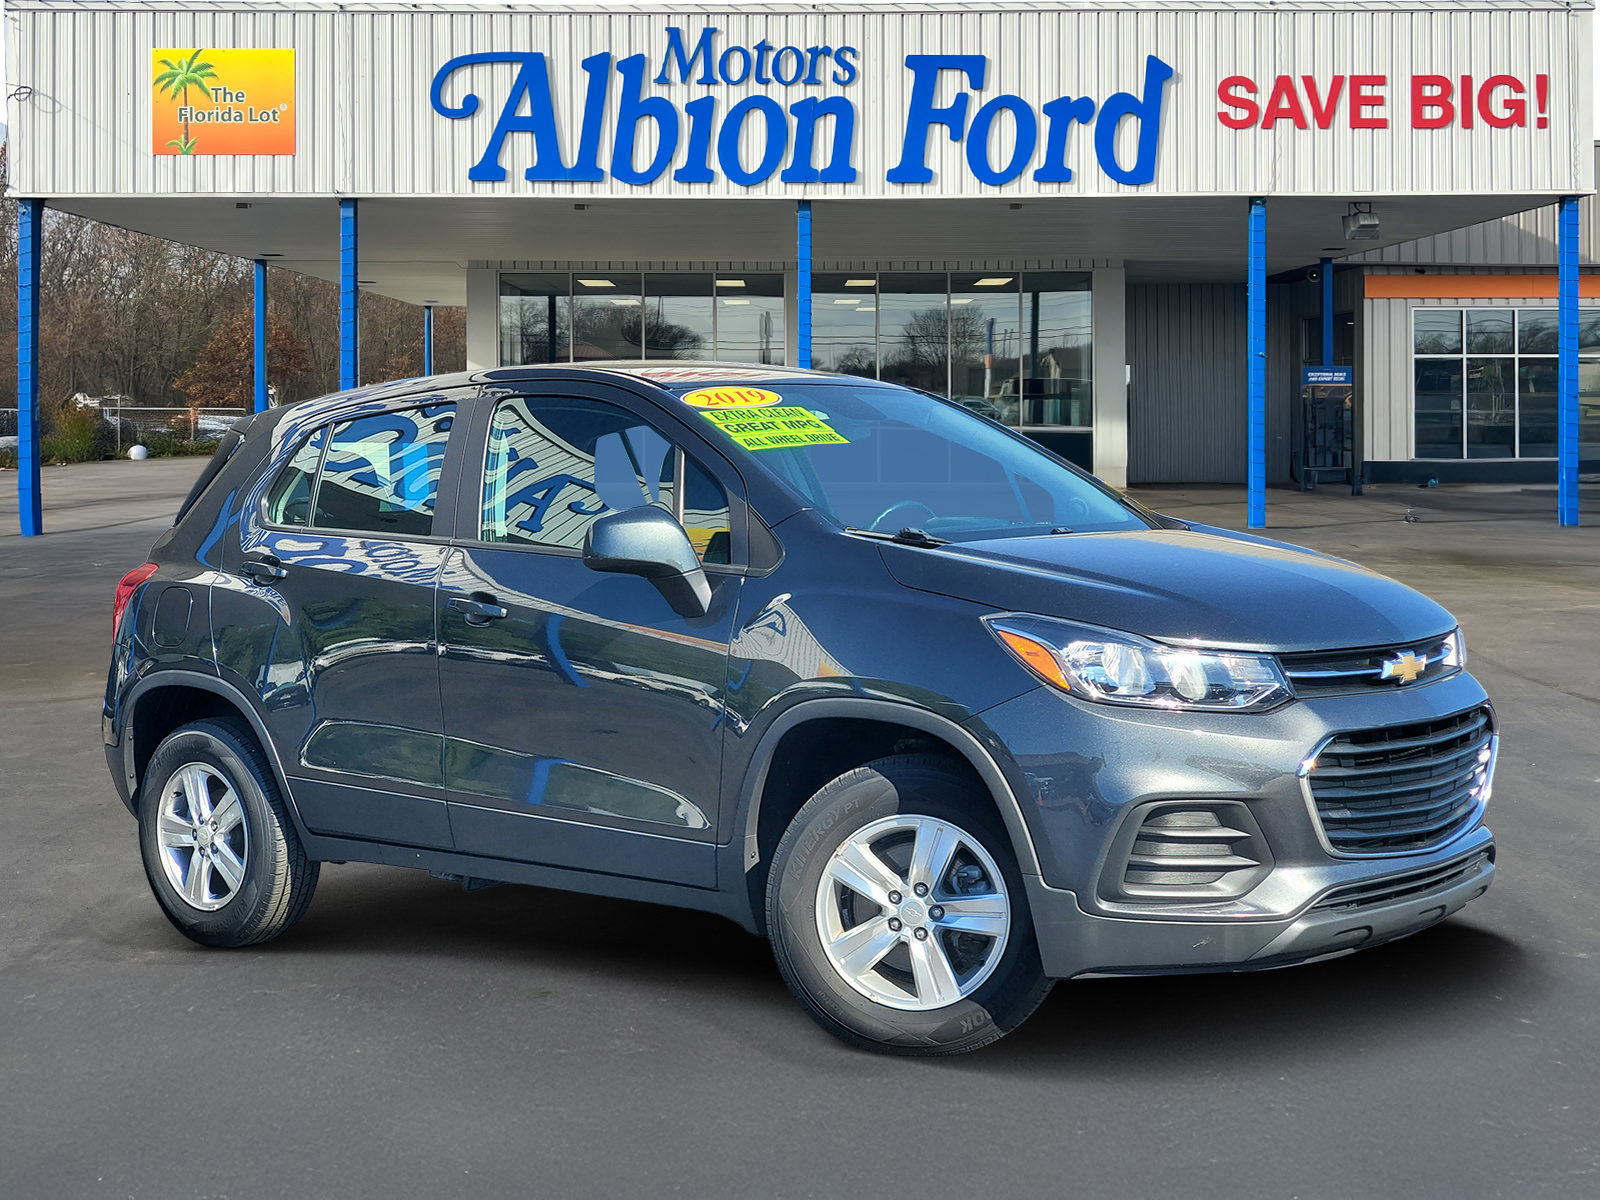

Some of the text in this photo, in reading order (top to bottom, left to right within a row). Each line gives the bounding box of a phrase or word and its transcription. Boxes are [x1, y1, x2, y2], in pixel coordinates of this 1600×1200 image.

[653, 28, 857, 85] Motors
[211, 87, 246, 103] The
[1217, 74, 1549, 129] SAVE BIG!
[177, 106, 244, 123] Florida
[430, 51, 1174, 187] Albion Ford
[695, 390, 767, 406] 2019
[709, 407, 805, 422] EXTRA CLEAN
[723, 419, 821, 434] GREAT MPG
[743, 431, 841, 447] ALL WHEEL DRIVE
